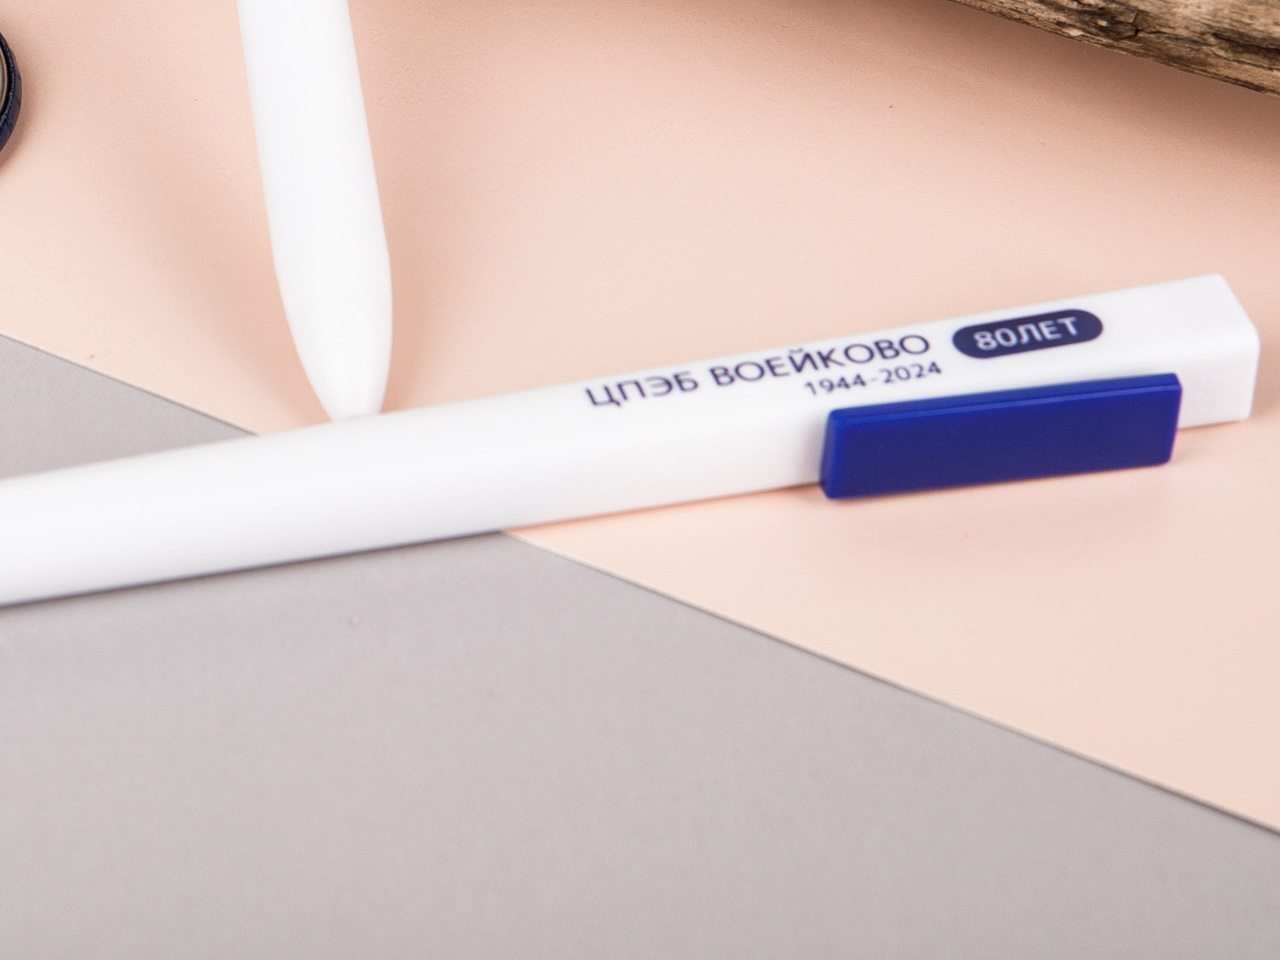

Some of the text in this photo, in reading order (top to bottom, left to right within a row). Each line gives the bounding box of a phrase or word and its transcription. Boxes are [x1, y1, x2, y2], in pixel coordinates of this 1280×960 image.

[973, 317, 1079, 351] 80ЛЕТ
[584, 334, 931, 409] ЦПЭБ ВОЕЙКОВО
[804, 361, 942, 398] 1944-2024
